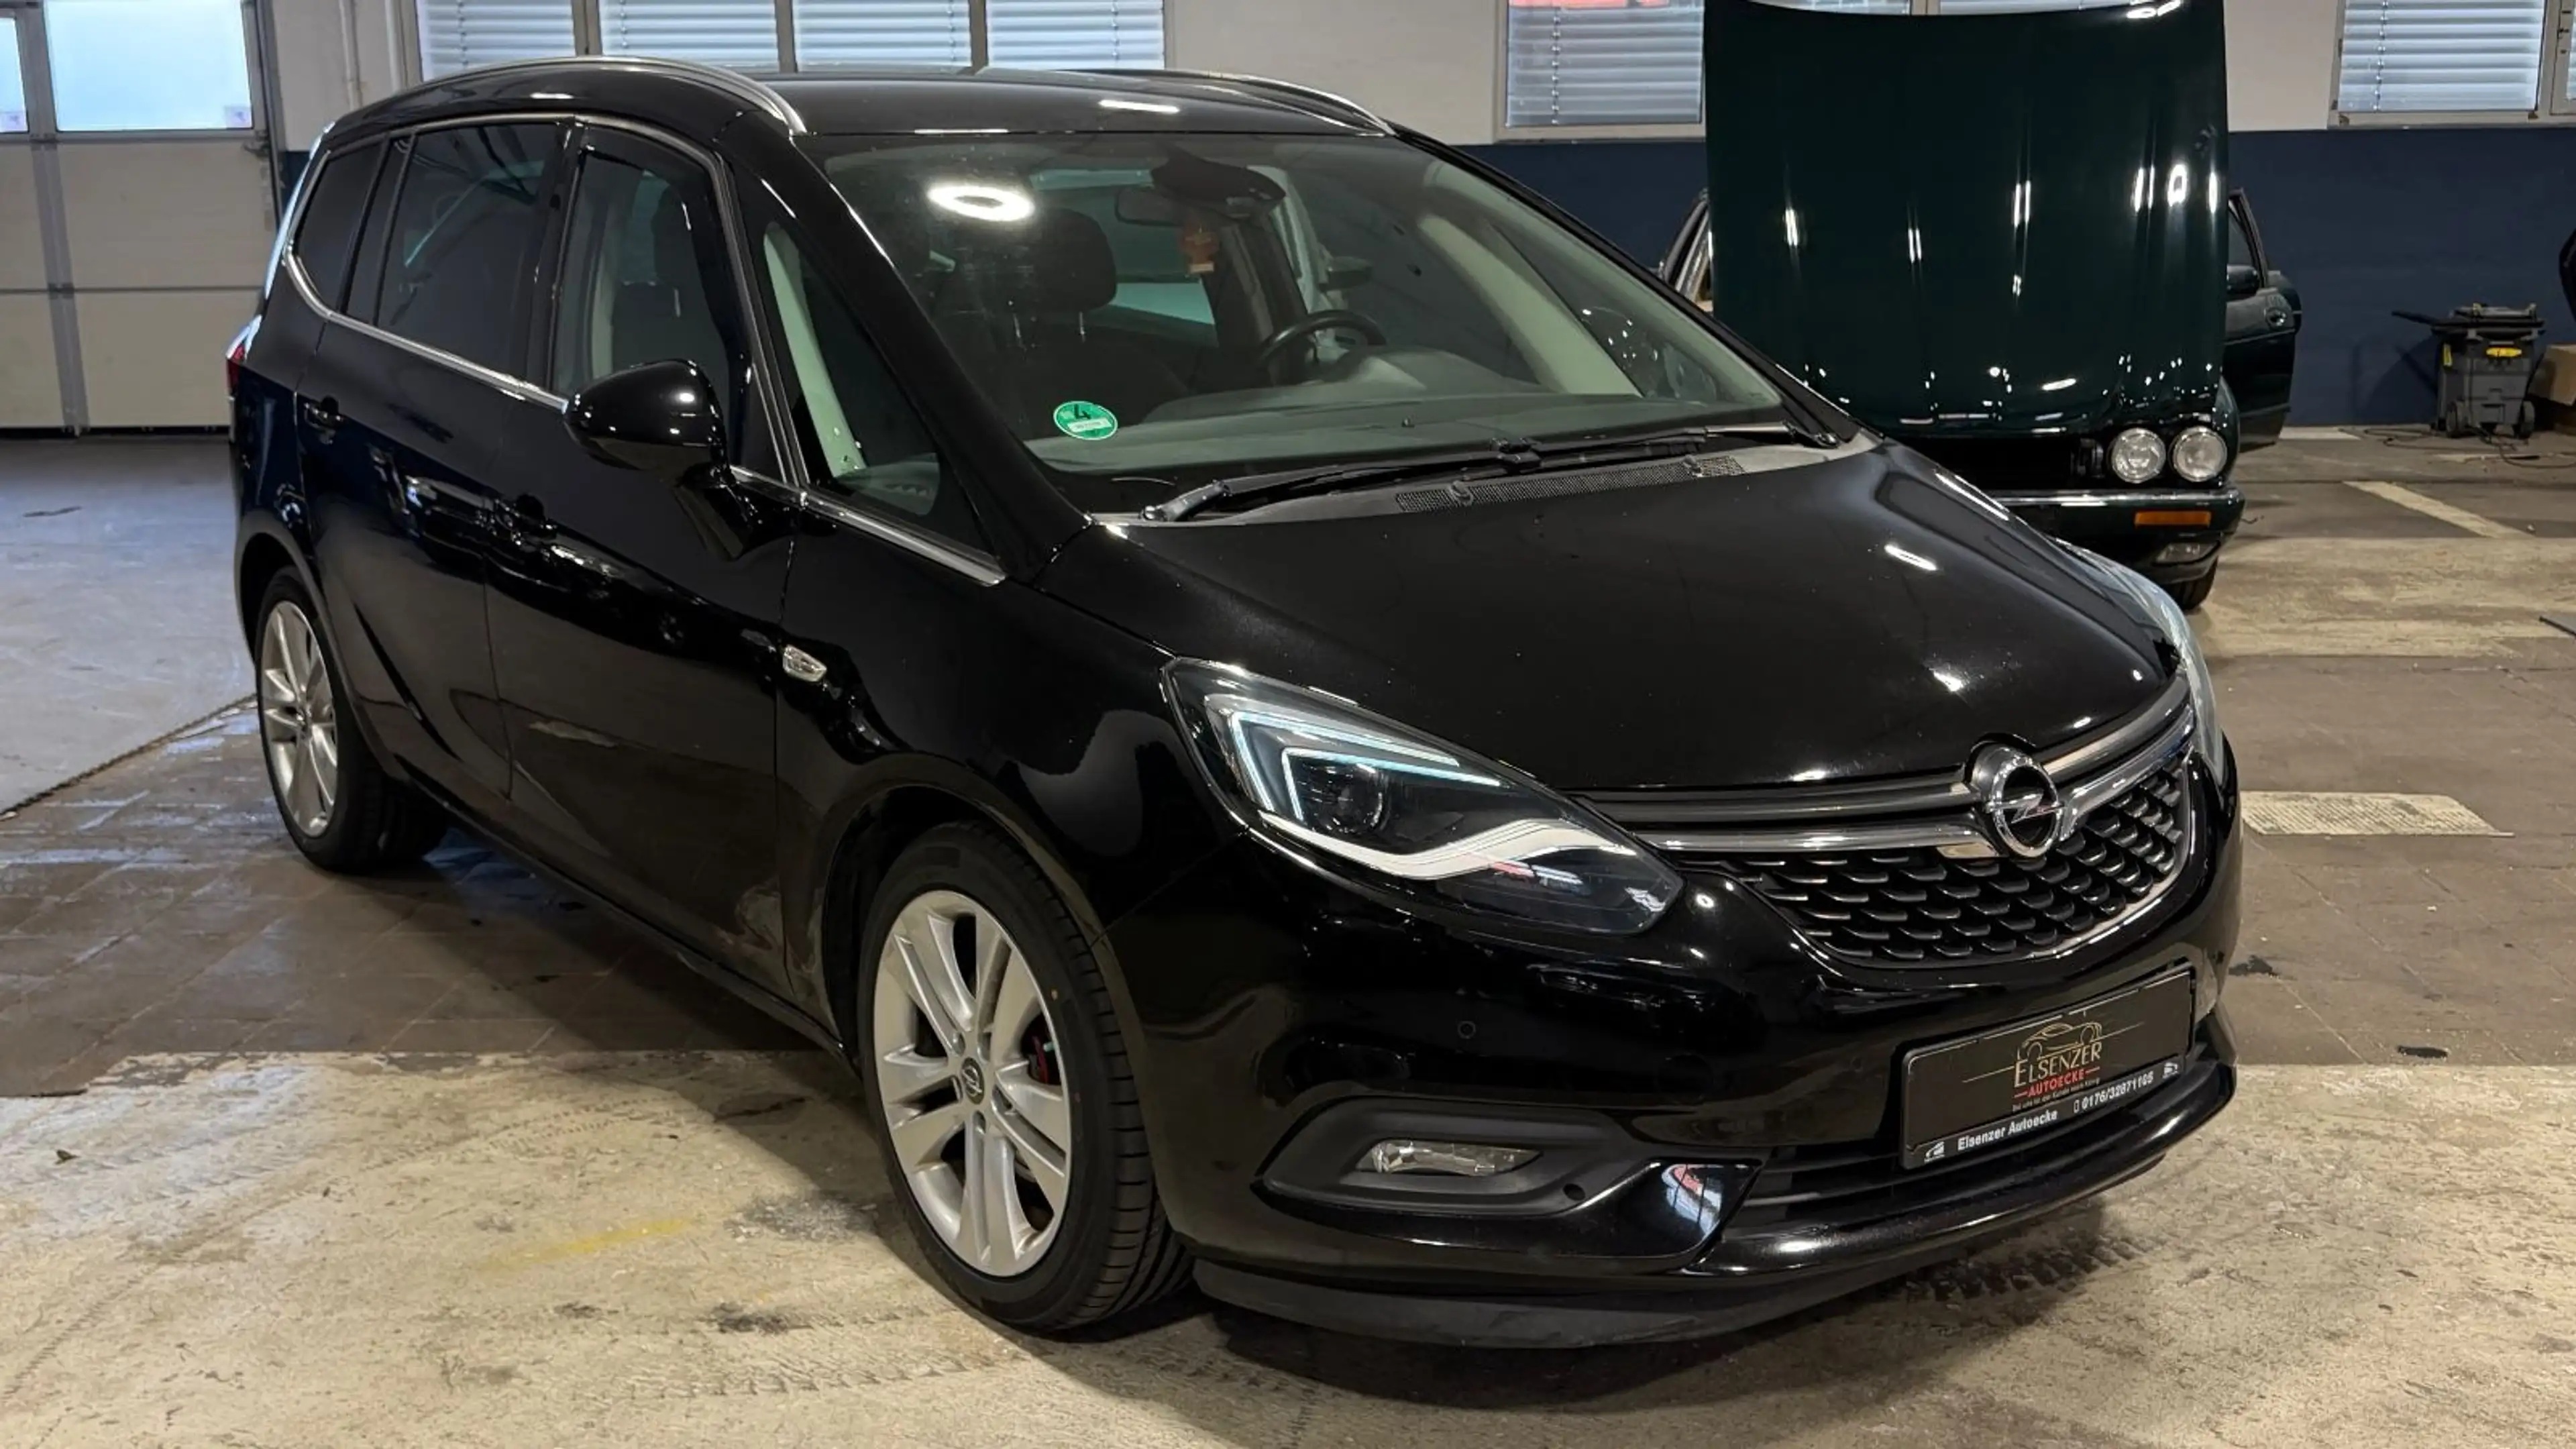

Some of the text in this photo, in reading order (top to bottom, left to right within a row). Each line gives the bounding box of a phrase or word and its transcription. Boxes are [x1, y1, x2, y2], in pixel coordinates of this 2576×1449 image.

[2015, 1041, 2102, 1087] ELSENZER
[2028, 1069, 2085, 1097] AUTOECKE
[1957, 1126, 2006, 1151] Elsenzer
[2008, 1110, 2058, 1136] Autoecke
